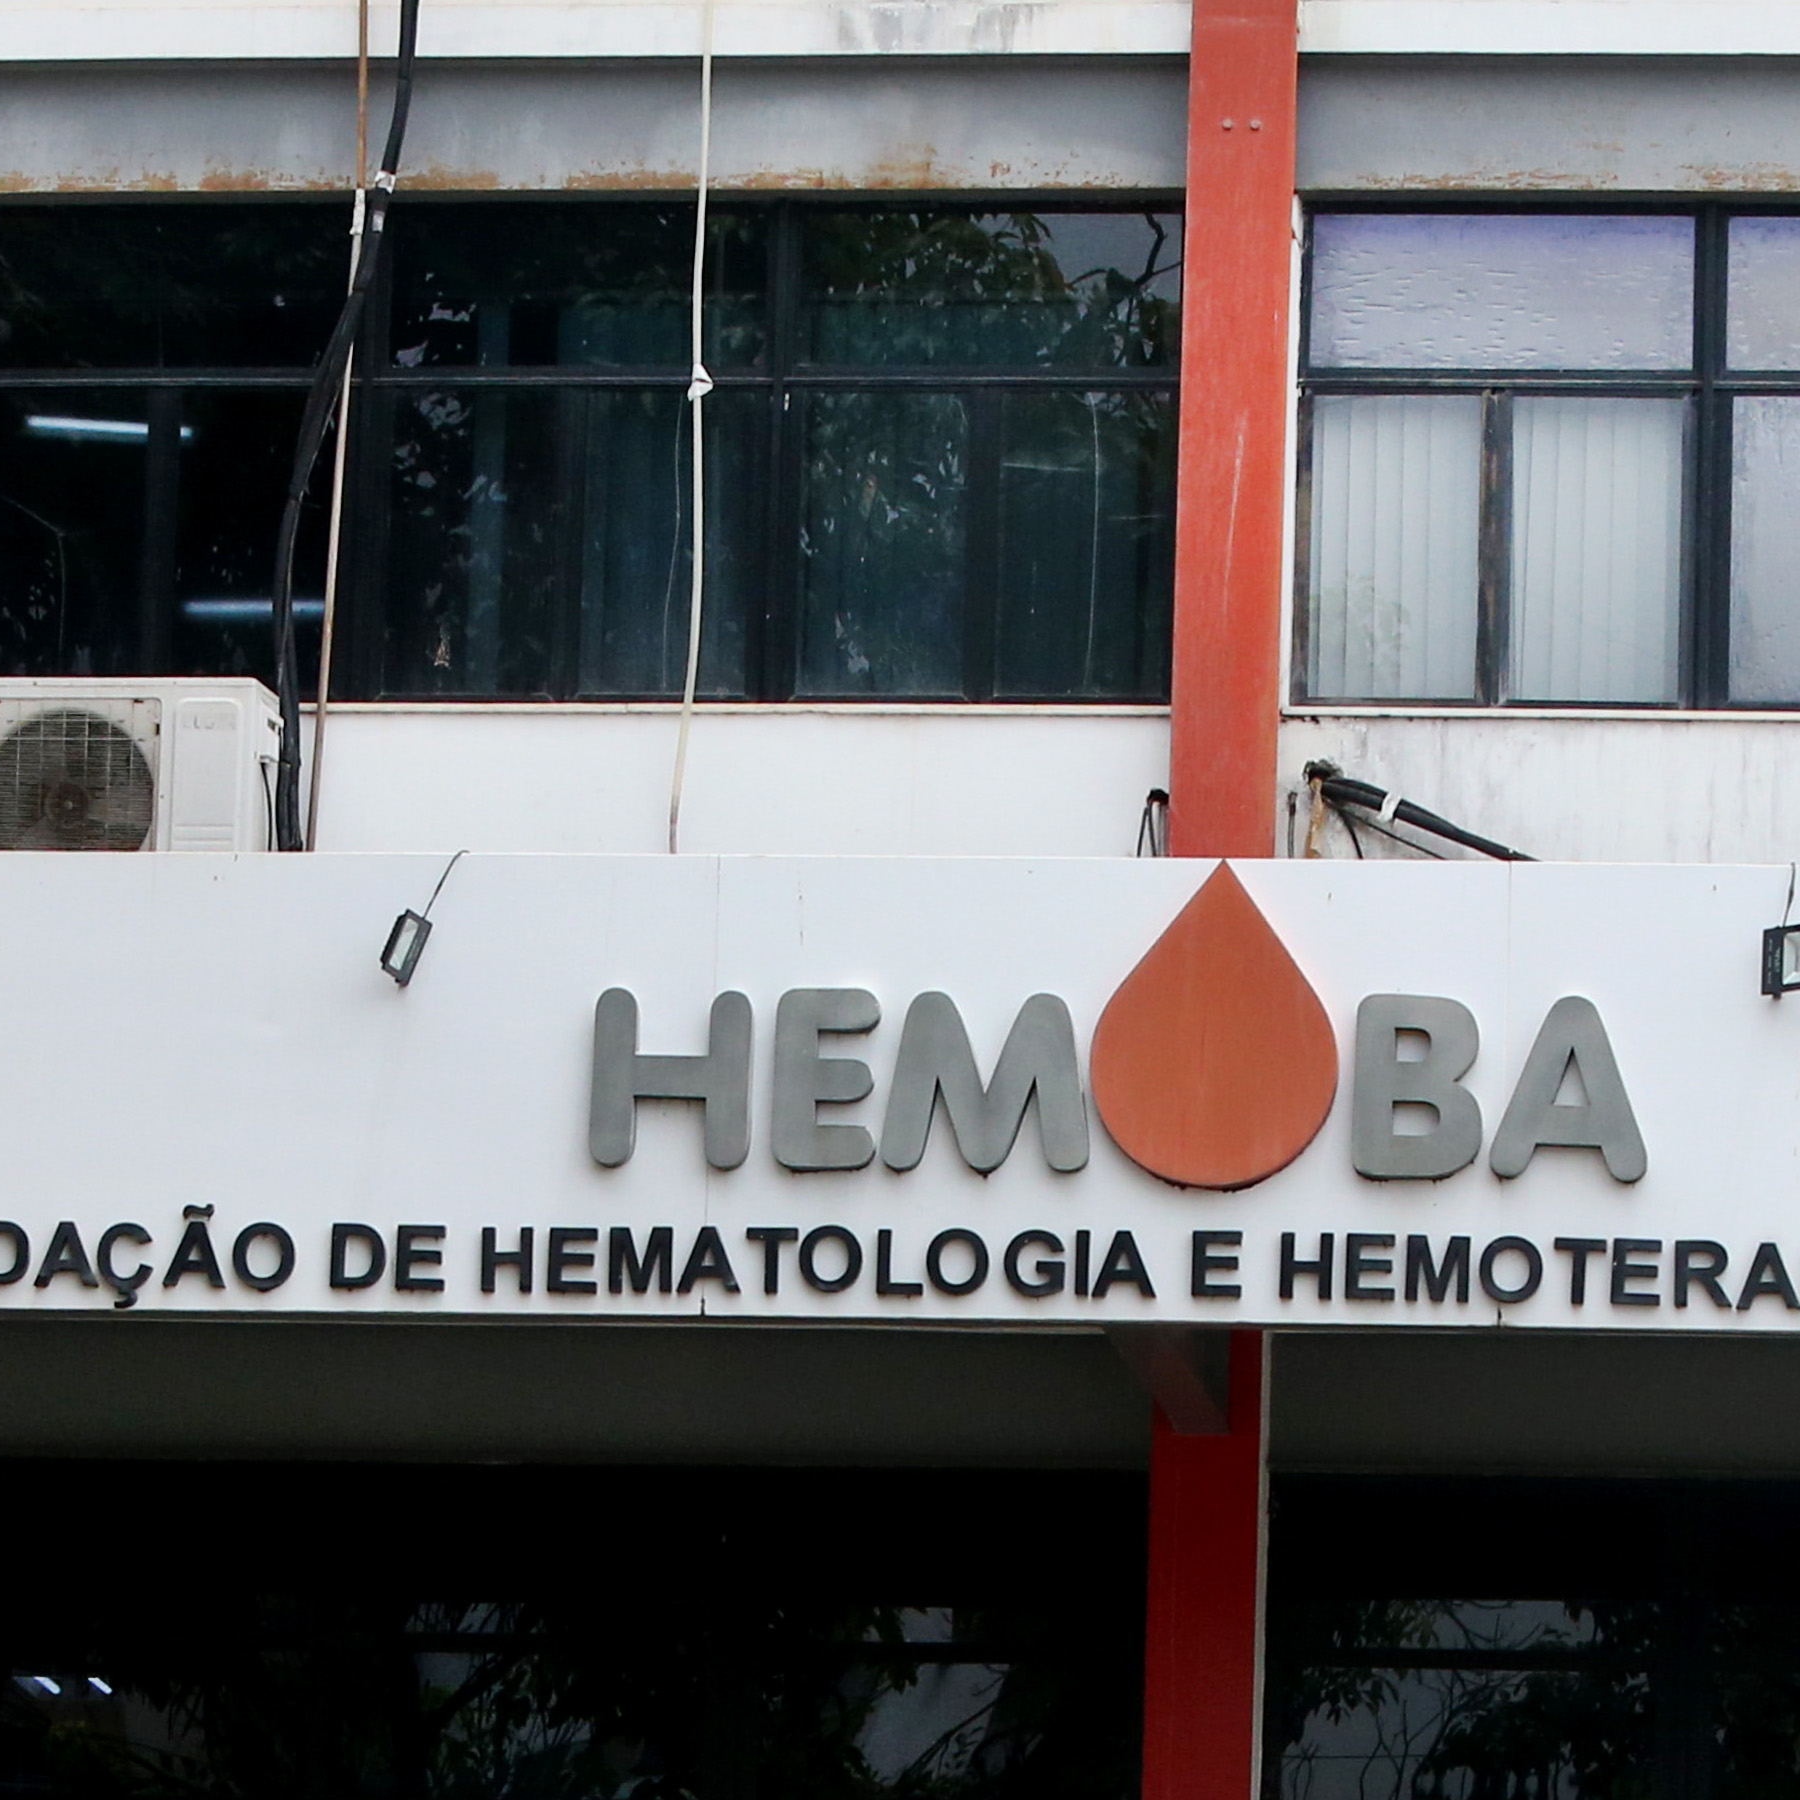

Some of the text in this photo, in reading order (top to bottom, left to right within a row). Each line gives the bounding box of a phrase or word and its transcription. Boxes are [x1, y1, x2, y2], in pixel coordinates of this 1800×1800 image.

[329, 1221, 447, 1293] DE
[480, 1224, 1156, 1299] HEMATOLOGIA
[1191, 1230, 1244, 1298] E
